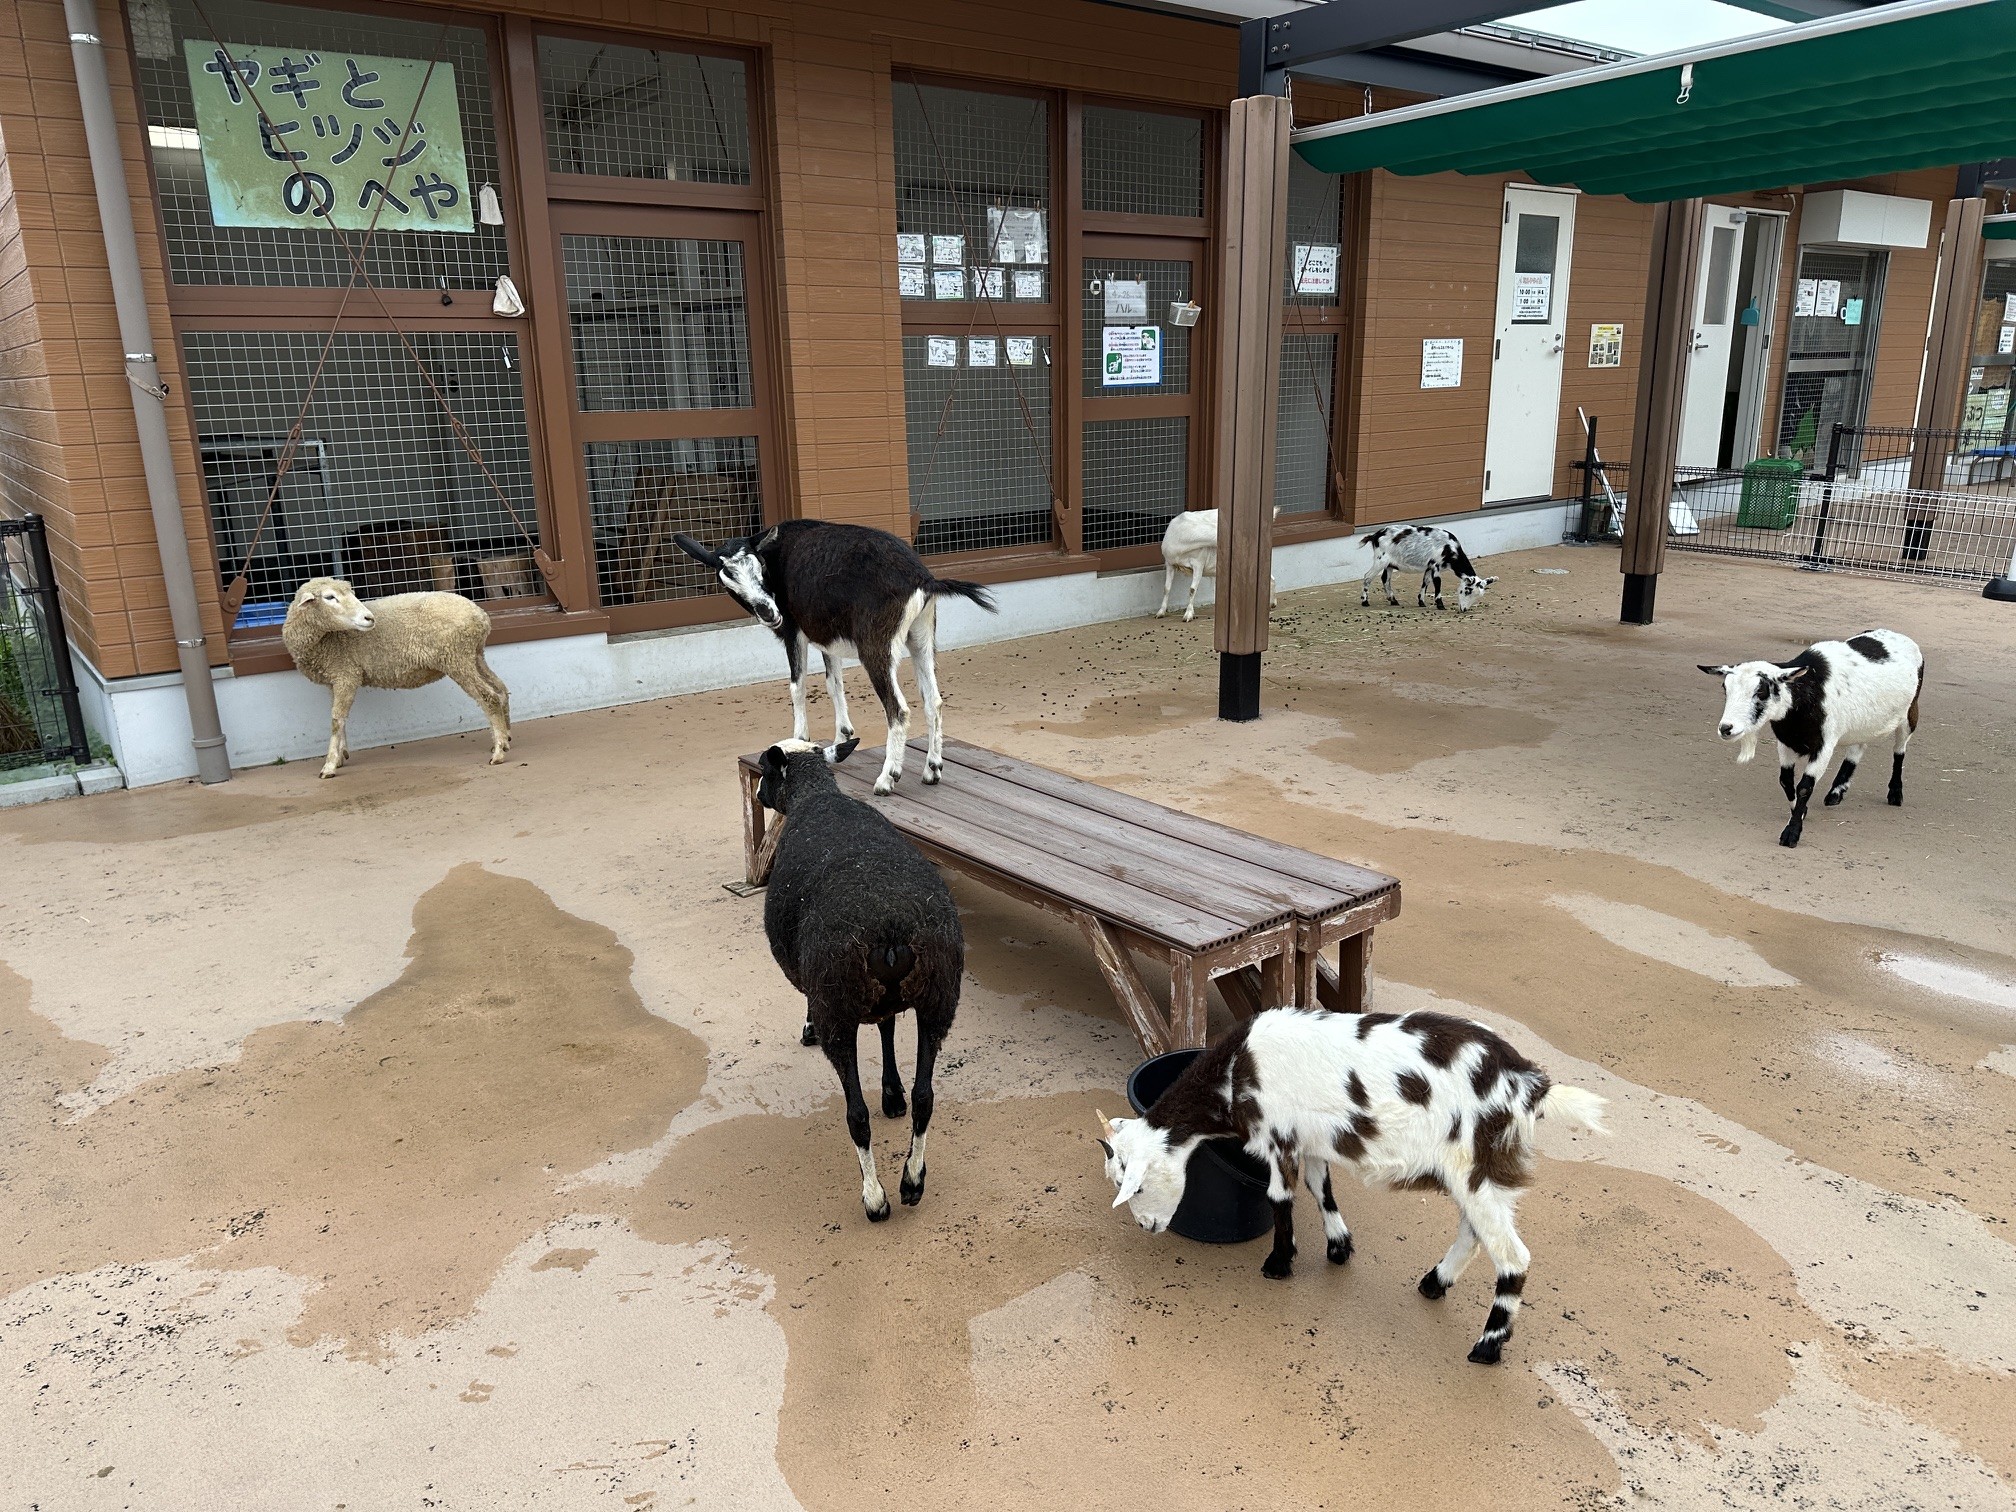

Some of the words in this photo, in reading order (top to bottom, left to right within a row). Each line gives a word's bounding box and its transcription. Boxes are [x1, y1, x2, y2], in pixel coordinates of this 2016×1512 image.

[204, 49, 385, 110] ヤギと
[257, 112, 427, 167] ヒツジ
[282, 171, 459, 221] のへや
